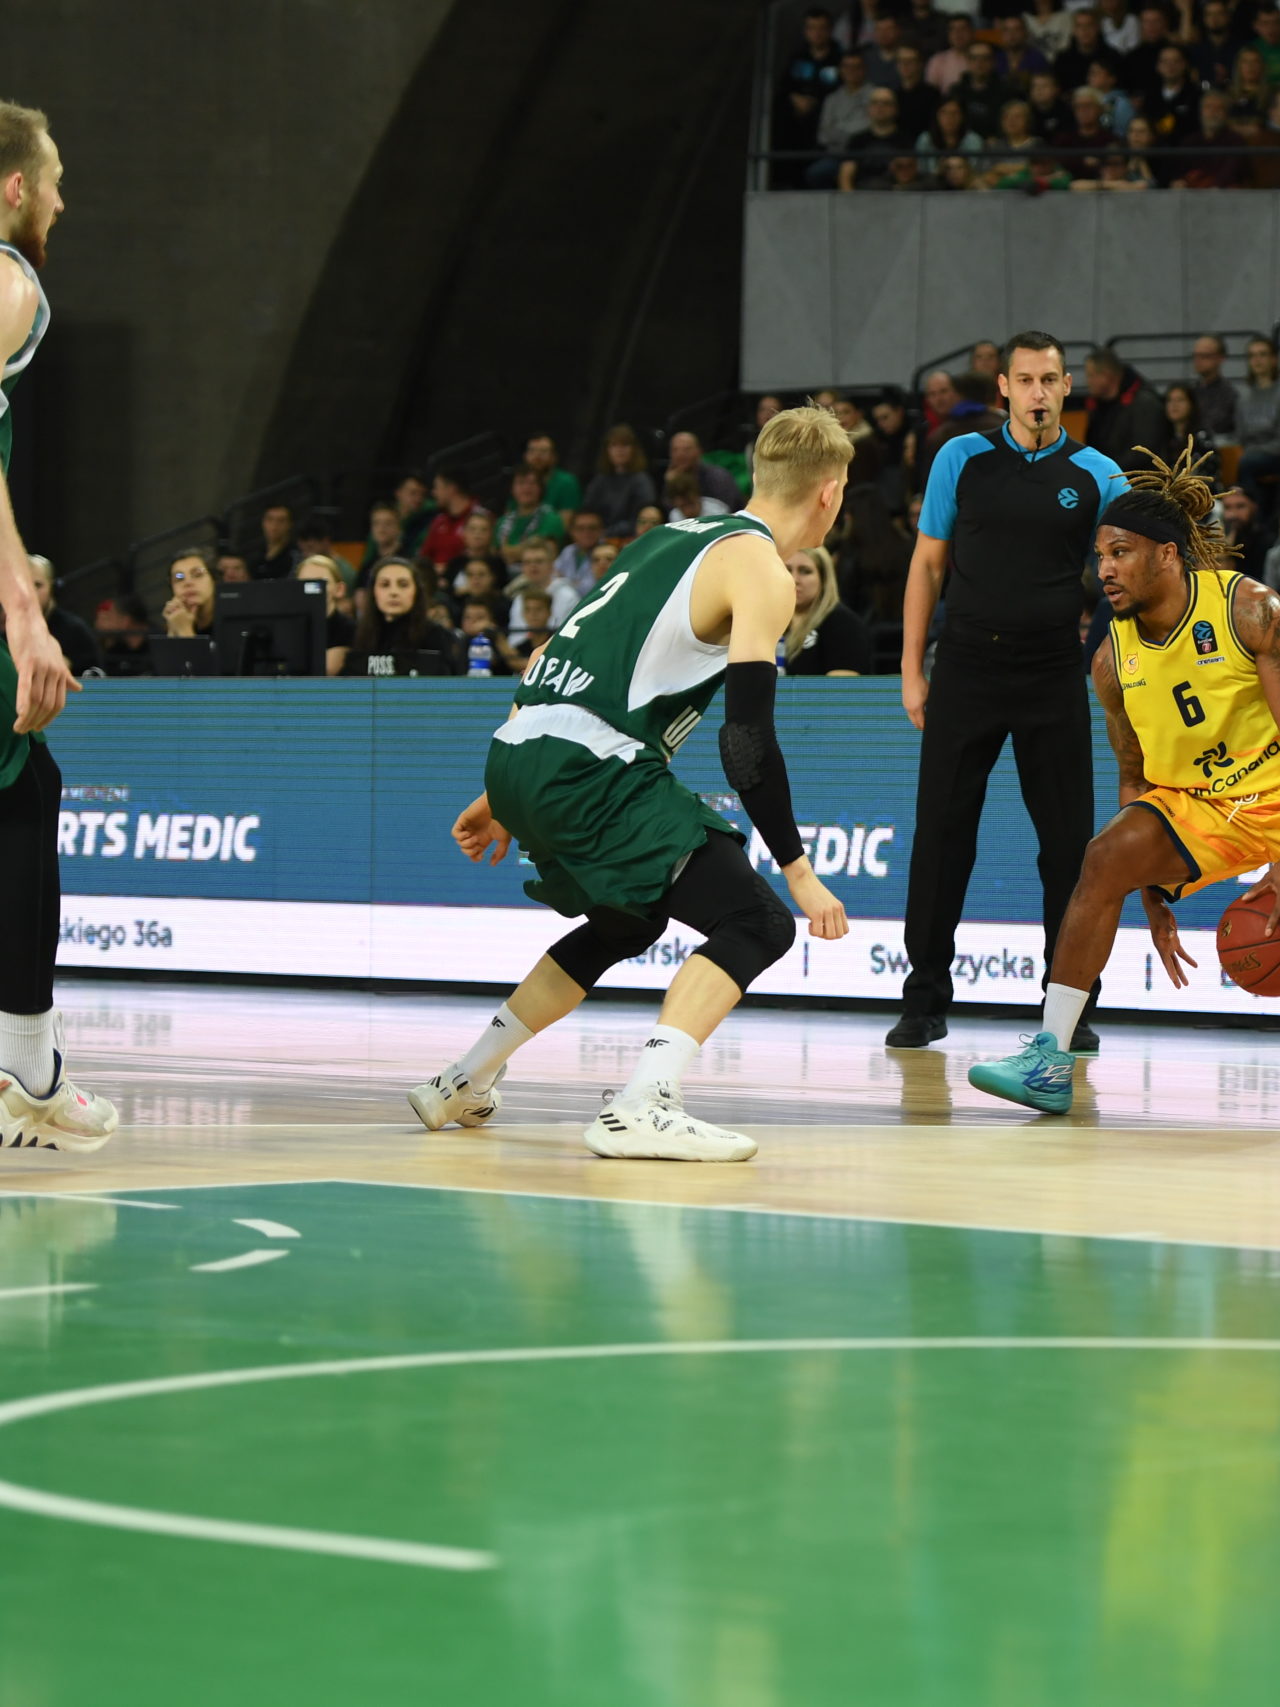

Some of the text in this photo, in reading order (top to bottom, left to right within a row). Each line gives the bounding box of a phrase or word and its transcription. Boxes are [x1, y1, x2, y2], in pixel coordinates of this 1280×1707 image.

[559, 571, 630, 639] 2
[1172, 680, 1206, 728] 6
[134, 813, 260, 862] MEDIC
[133, 919, 173, 948] 36a
